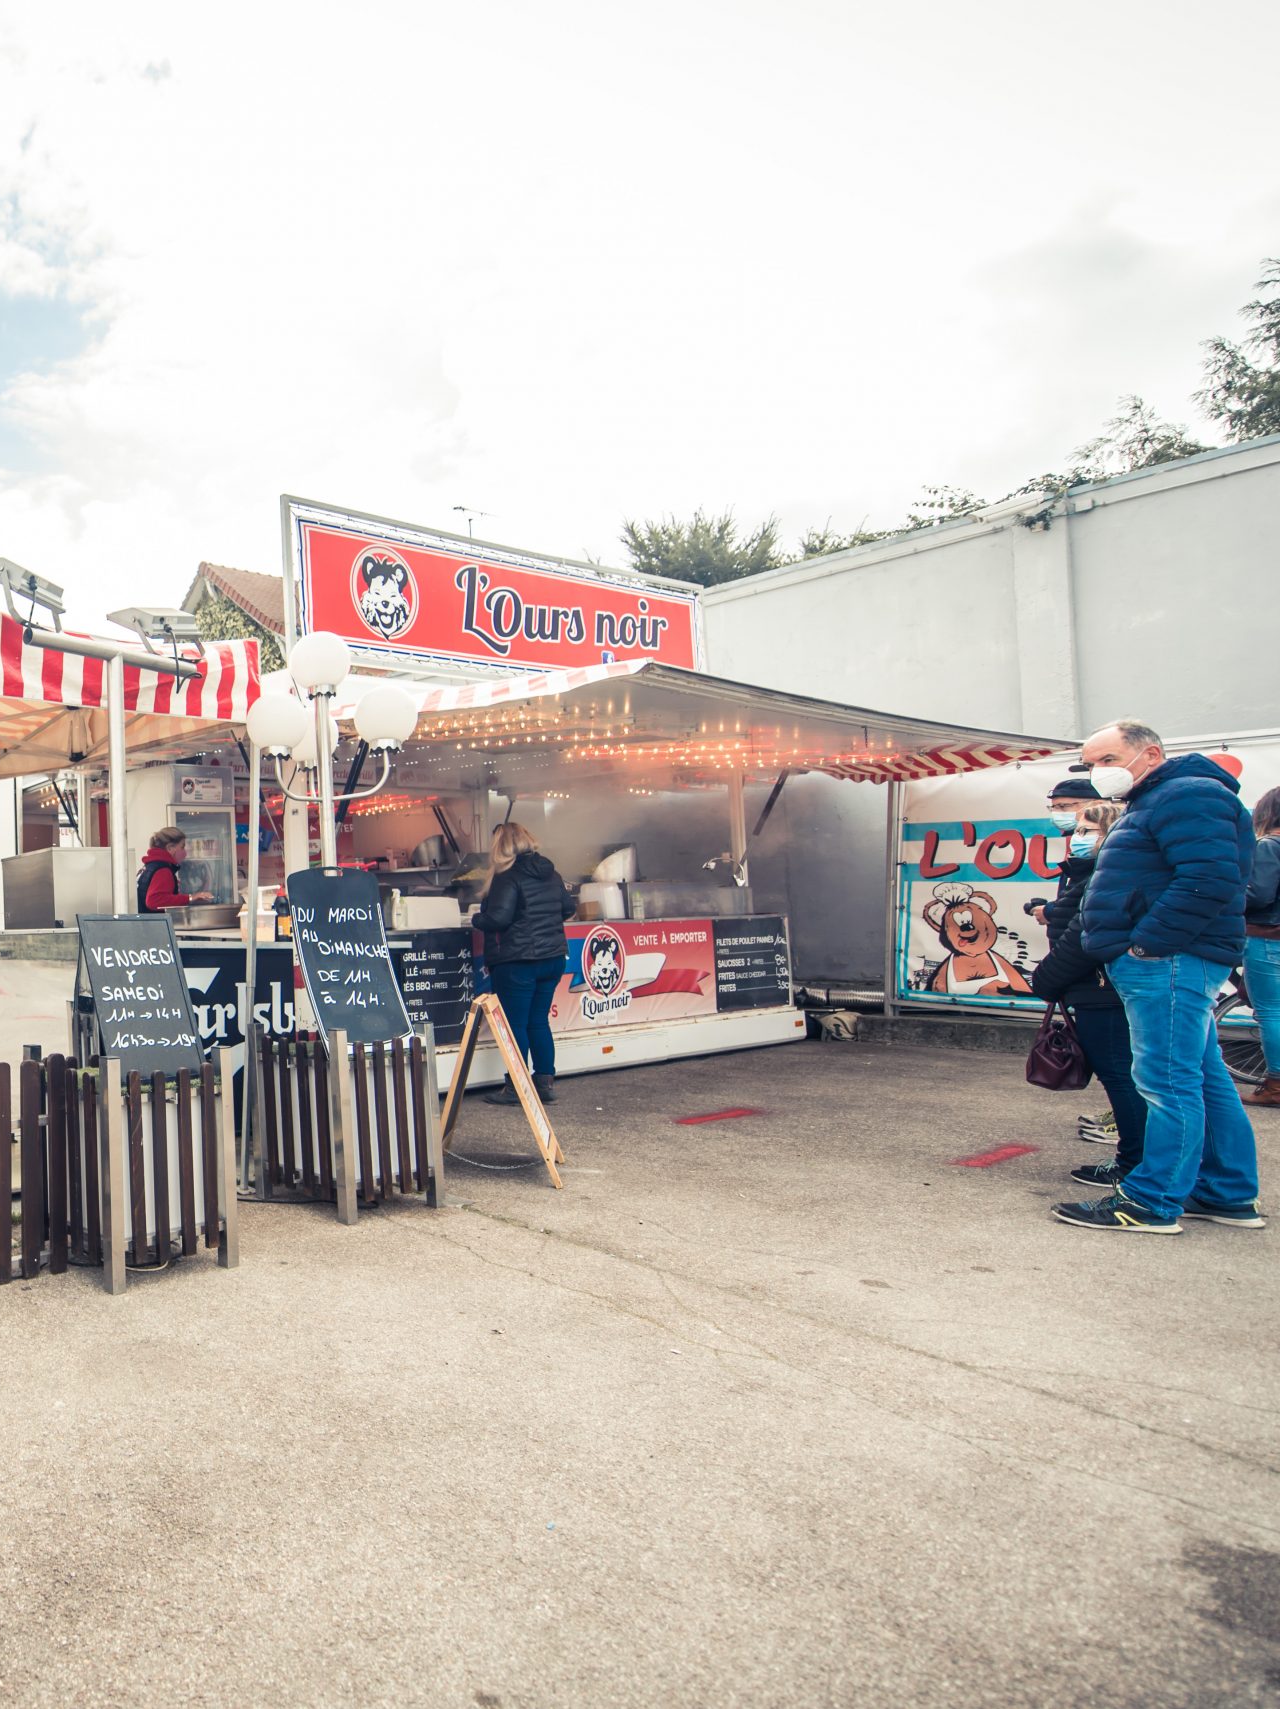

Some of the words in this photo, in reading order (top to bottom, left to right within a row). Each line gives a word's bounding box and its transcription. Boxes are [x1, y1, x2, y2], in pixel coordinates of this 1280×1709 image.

[455, 564, 585, 655] L'Ours
[596, 599, 667, 649] noir
[920, 821, 1070, 880] L'OU
[297, 908, 314, 923] DU
[302, 929, 318, 943] AU
[633, 934, 658, 946] VENTE
[661, 931, 668, 945] À
[670, 931, 707, 944] EMPORTER
[716, 938, 732, 946] FILETS
[732, 937, 739, 945] DE
[739, 936, 756, 944] POULET
[717, 958, 745, 968] SAUCISSES
[747, 958, 751, 966] 2
[317, 970, 340, 982] DE
[718, 972, 735, 980] FRITES
[415, 981, 431, 991] BBQ
[719, 984, 736, 992] FRITES
[582, 994, 610, 1020] L'Ours
[611, 992, 631, 1010] noir
